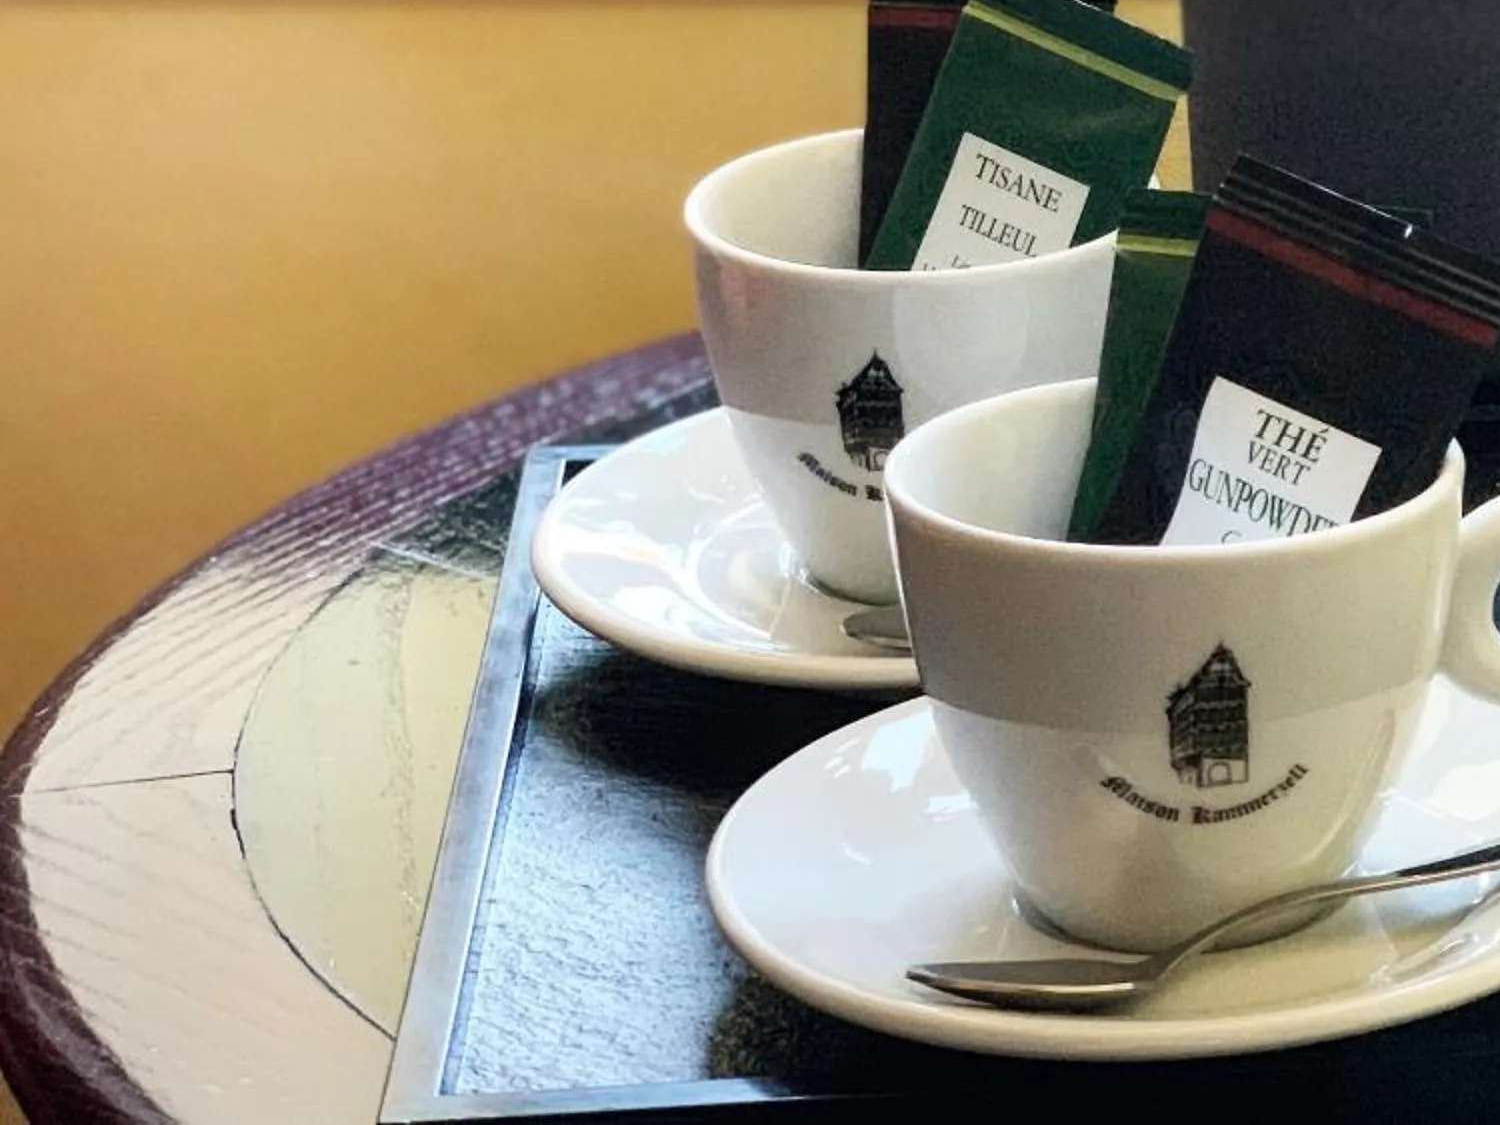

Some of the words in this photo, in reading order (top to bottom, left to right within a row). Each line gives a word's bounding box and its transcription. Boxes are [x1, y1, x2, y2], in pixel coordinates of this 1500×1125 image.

[975, 152, 1063, 213] TISANE
[959, 204, 1038, 258] TILLEUL
[1247, 440, 1312, 487] VERT
[1255, 408, 1328, 464] THÉ
[1188, 458, 1342, 538] GUNPOWDE
[1099, 776, 1182, 823] Maison
